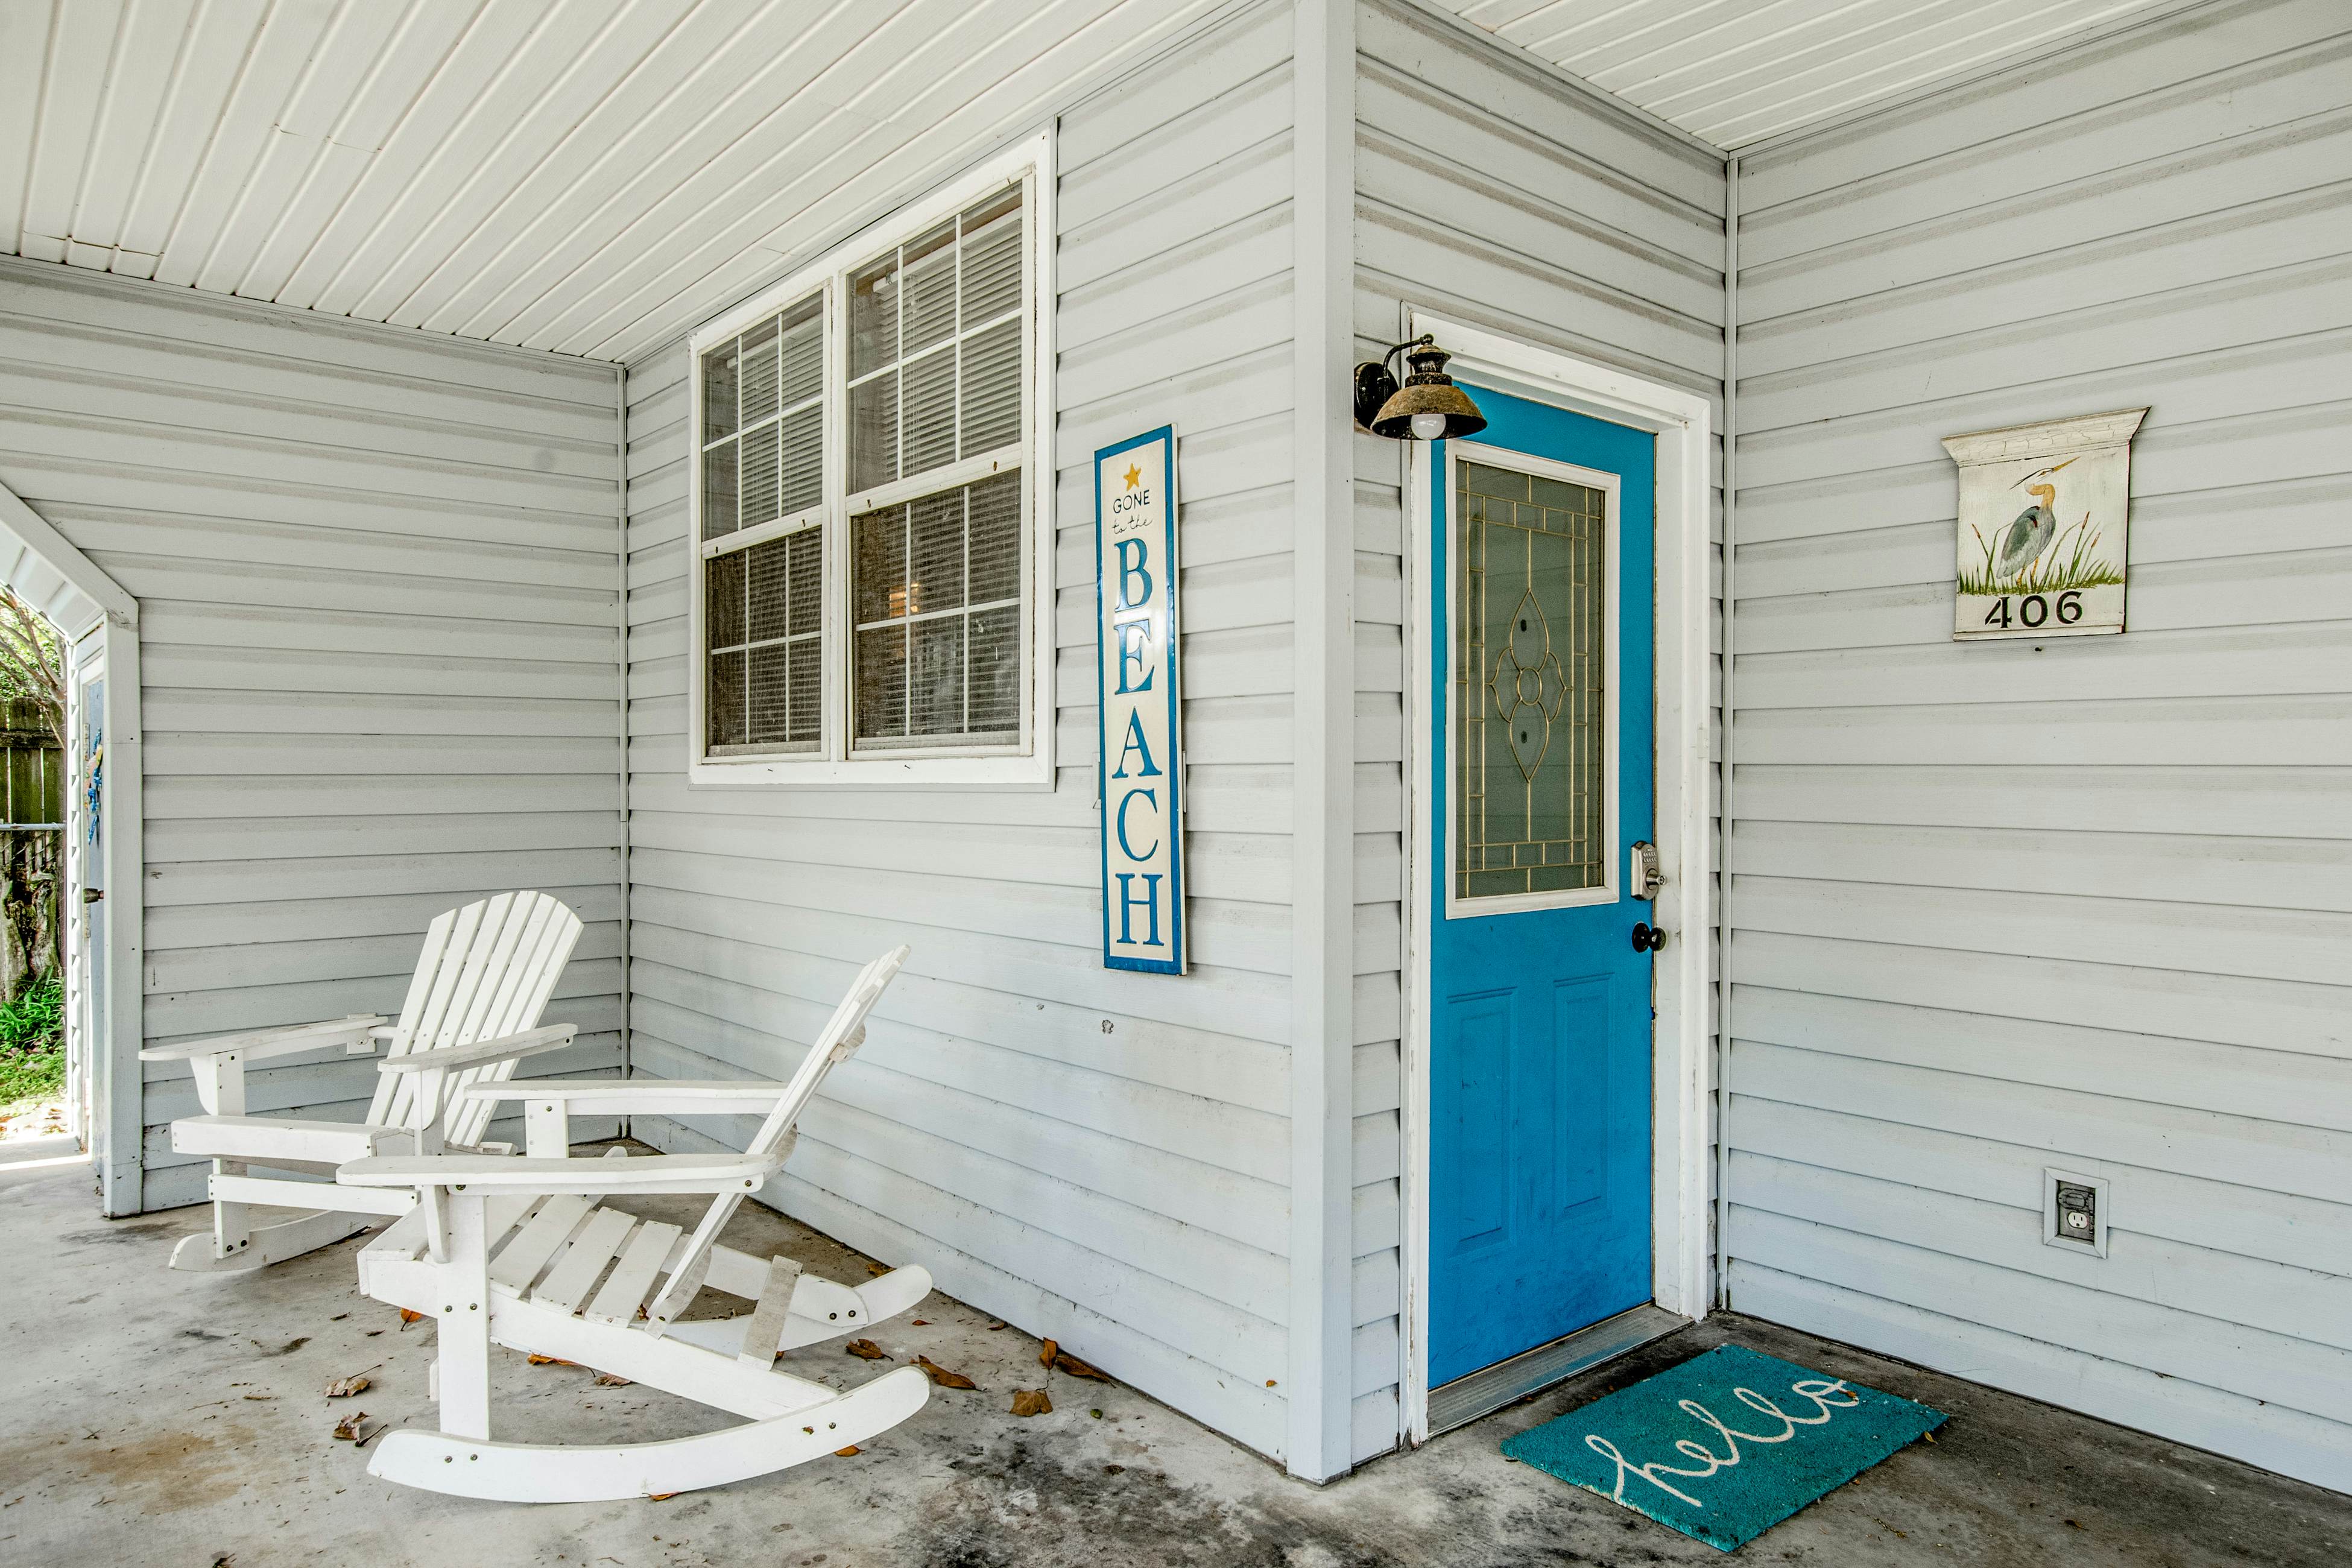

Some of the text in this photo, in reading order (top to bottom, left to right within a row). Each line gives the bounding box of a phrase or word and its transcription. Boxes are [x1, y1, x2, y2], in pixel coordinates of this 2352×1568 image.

[1113, 489, 1150, 514] GONE
[1111, 514, 1153, 534] to the
[1984, 590, 2083, 628] 406
[1112, 538, 1163, 947] BEACH
[1585, 1379, 1860, 1508] hello
